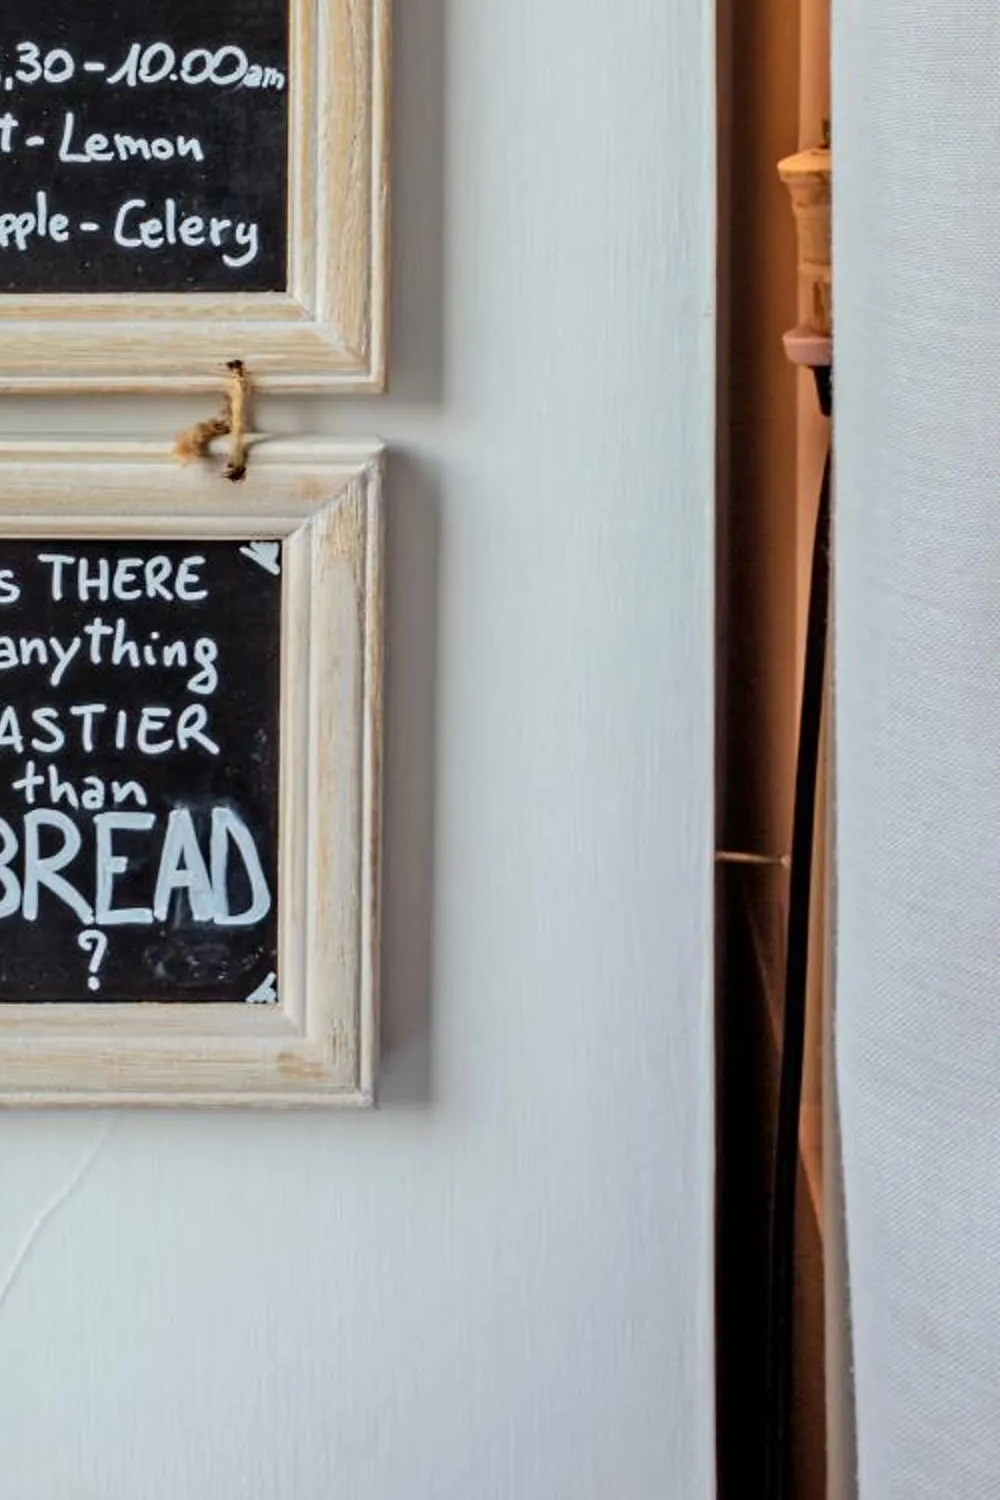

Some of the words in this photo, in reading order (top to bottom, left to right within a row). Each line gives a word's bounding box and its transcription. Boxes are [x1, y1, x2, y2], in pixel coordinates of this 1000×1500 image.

[58, 111, 205, 163] Lemon
[113, 198, 259, 268] Celery
[37, 553, 209, 602] THERE
[12, 760, 148, 810] than
[77, 929, 108, 991] ?
